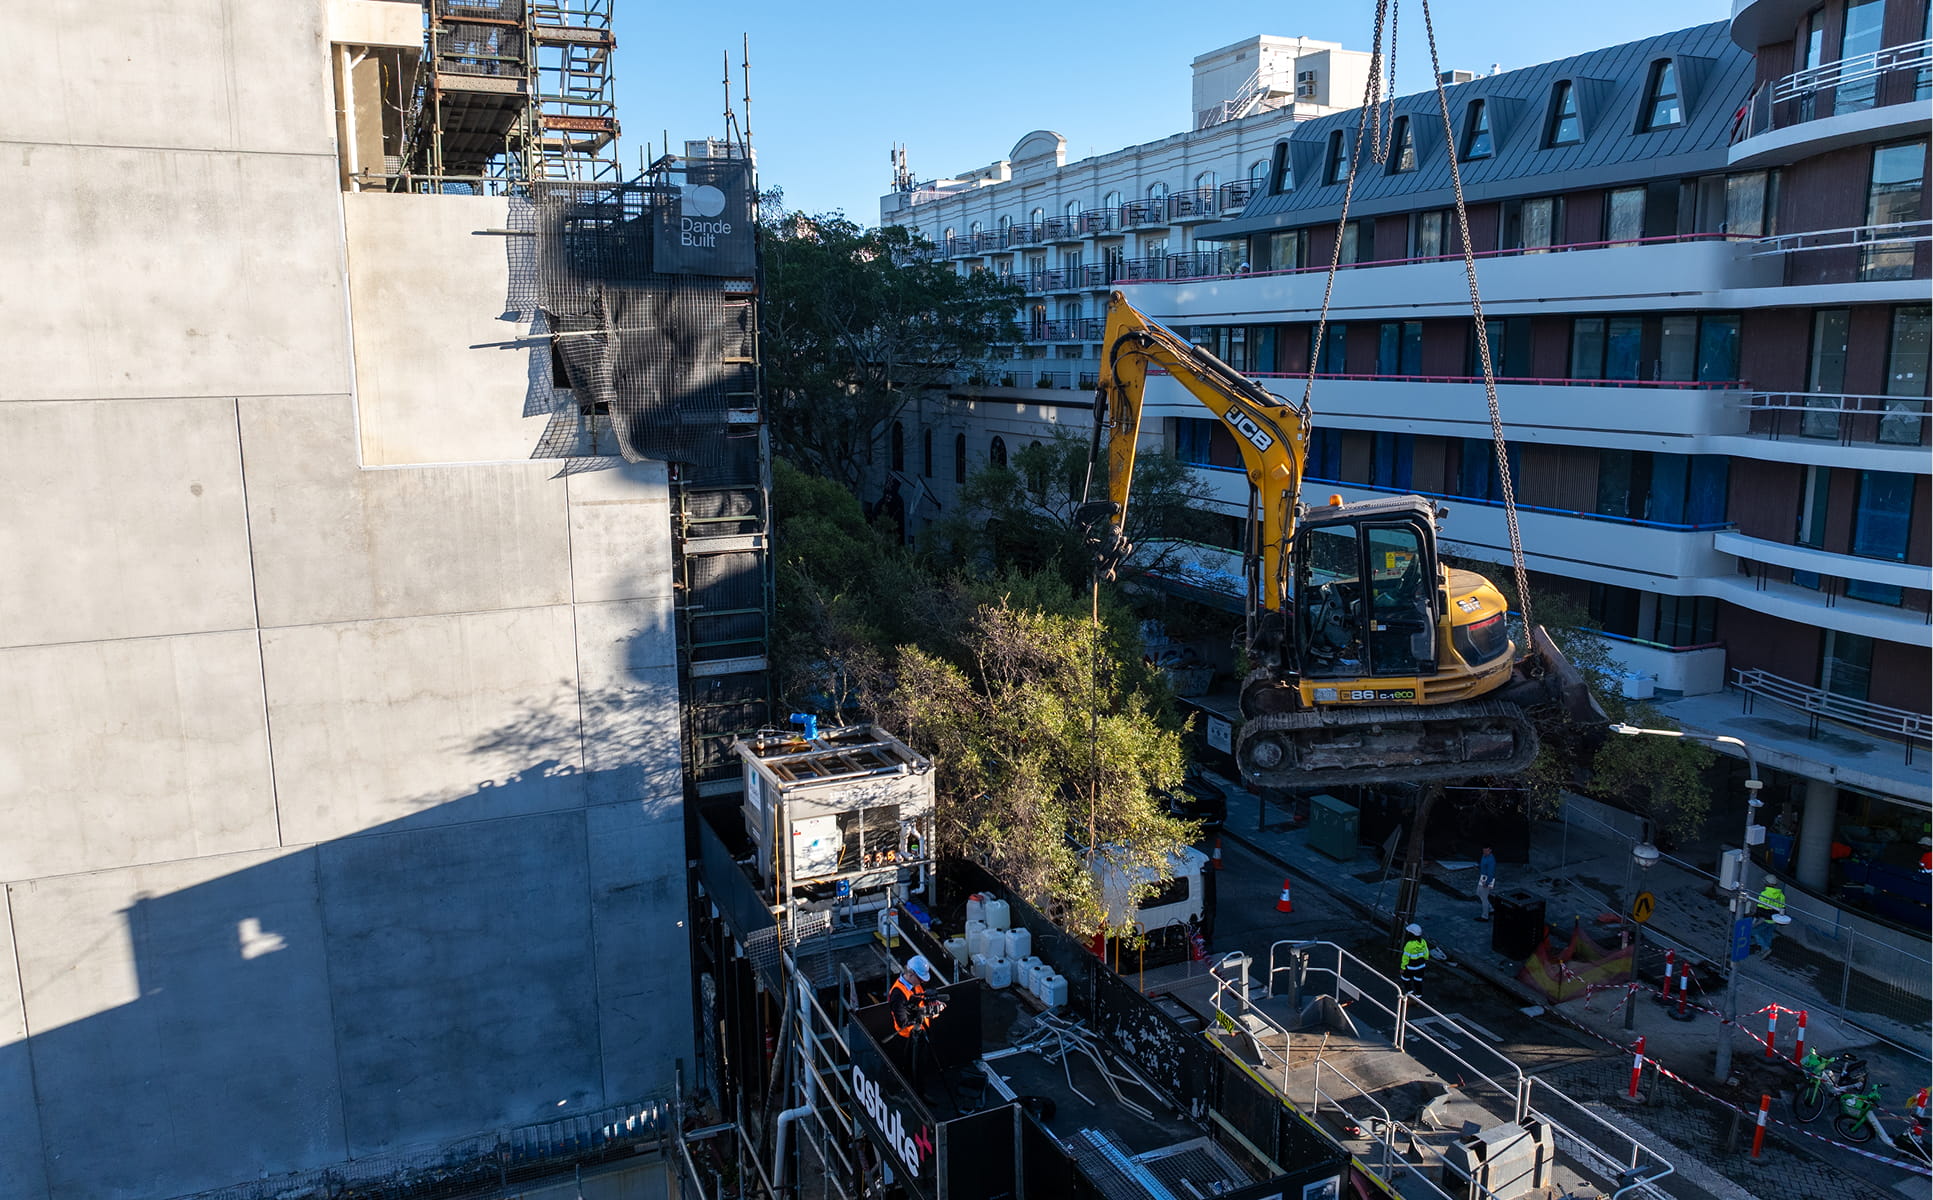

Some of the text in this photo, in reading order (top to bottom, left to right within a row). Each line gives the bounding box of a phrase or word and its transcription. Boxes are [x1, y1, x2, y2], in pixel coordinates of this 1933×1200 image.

[681, 217, 732, 235] Dande
[681, 232, 716, 248] Built
[1225, 406, 1272, 451] JCB
[1351, 690, 1375, 700] 86
[1736, 936, 1748, 953] P
